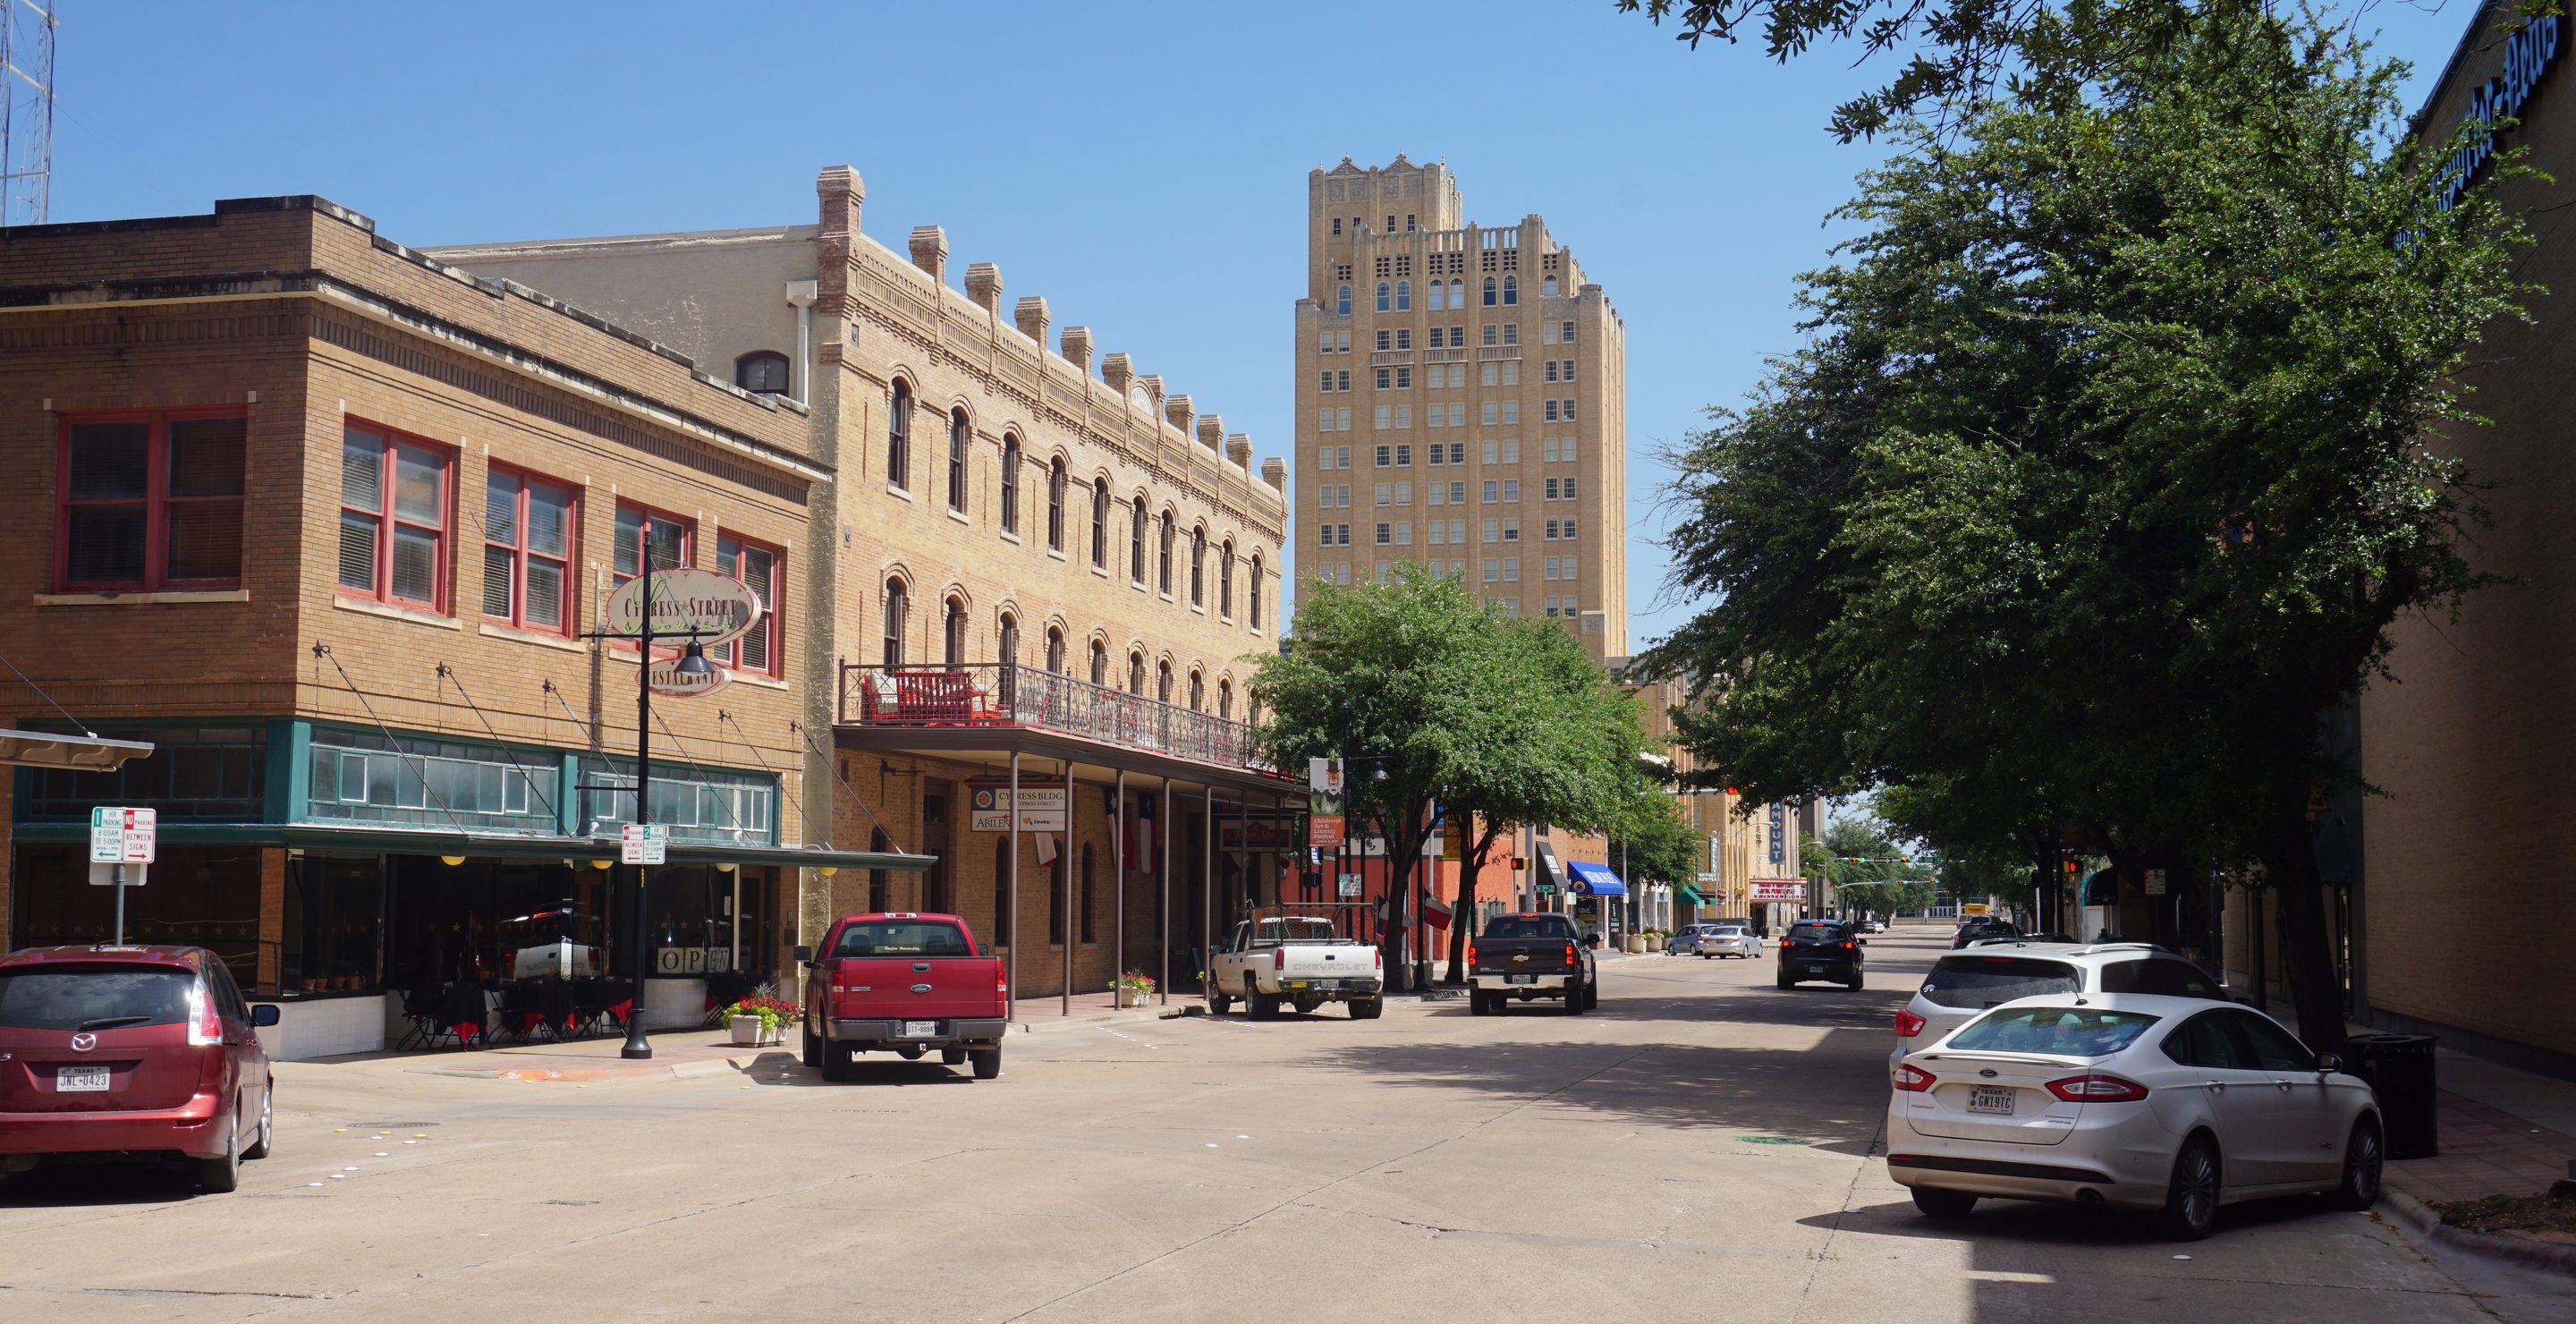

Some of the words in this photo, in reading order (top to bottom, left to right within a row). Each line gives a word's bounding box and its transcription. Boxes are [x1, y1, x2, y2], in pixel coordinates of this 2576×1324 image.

[625, 598, 680, 617] CYRESS
[689, 597, 737, 617] STREET
[652, 671, 716, 685] ESTAURANT
[999, 792, 1036, 800] CYRESS
[1038, 792, 1065, 800] BLDG.
[96, 811, 99, 825] 1
[103, 819, 122, 827] PARKING
[976, 818, 1012, 828] ABILEN
[644, 828, 650, 838] 2
[1772, 802, 1782, 860] AMOUNT
[126, 833, 151, 841] BETWEEN
[129, 843, 148, 851] SIGNS
[662, 951, 729, 971] OPEN
[1292, 963, 1368, 971] CHEVROLET
[1978, 1096, 2012, 1109] GN19TC
